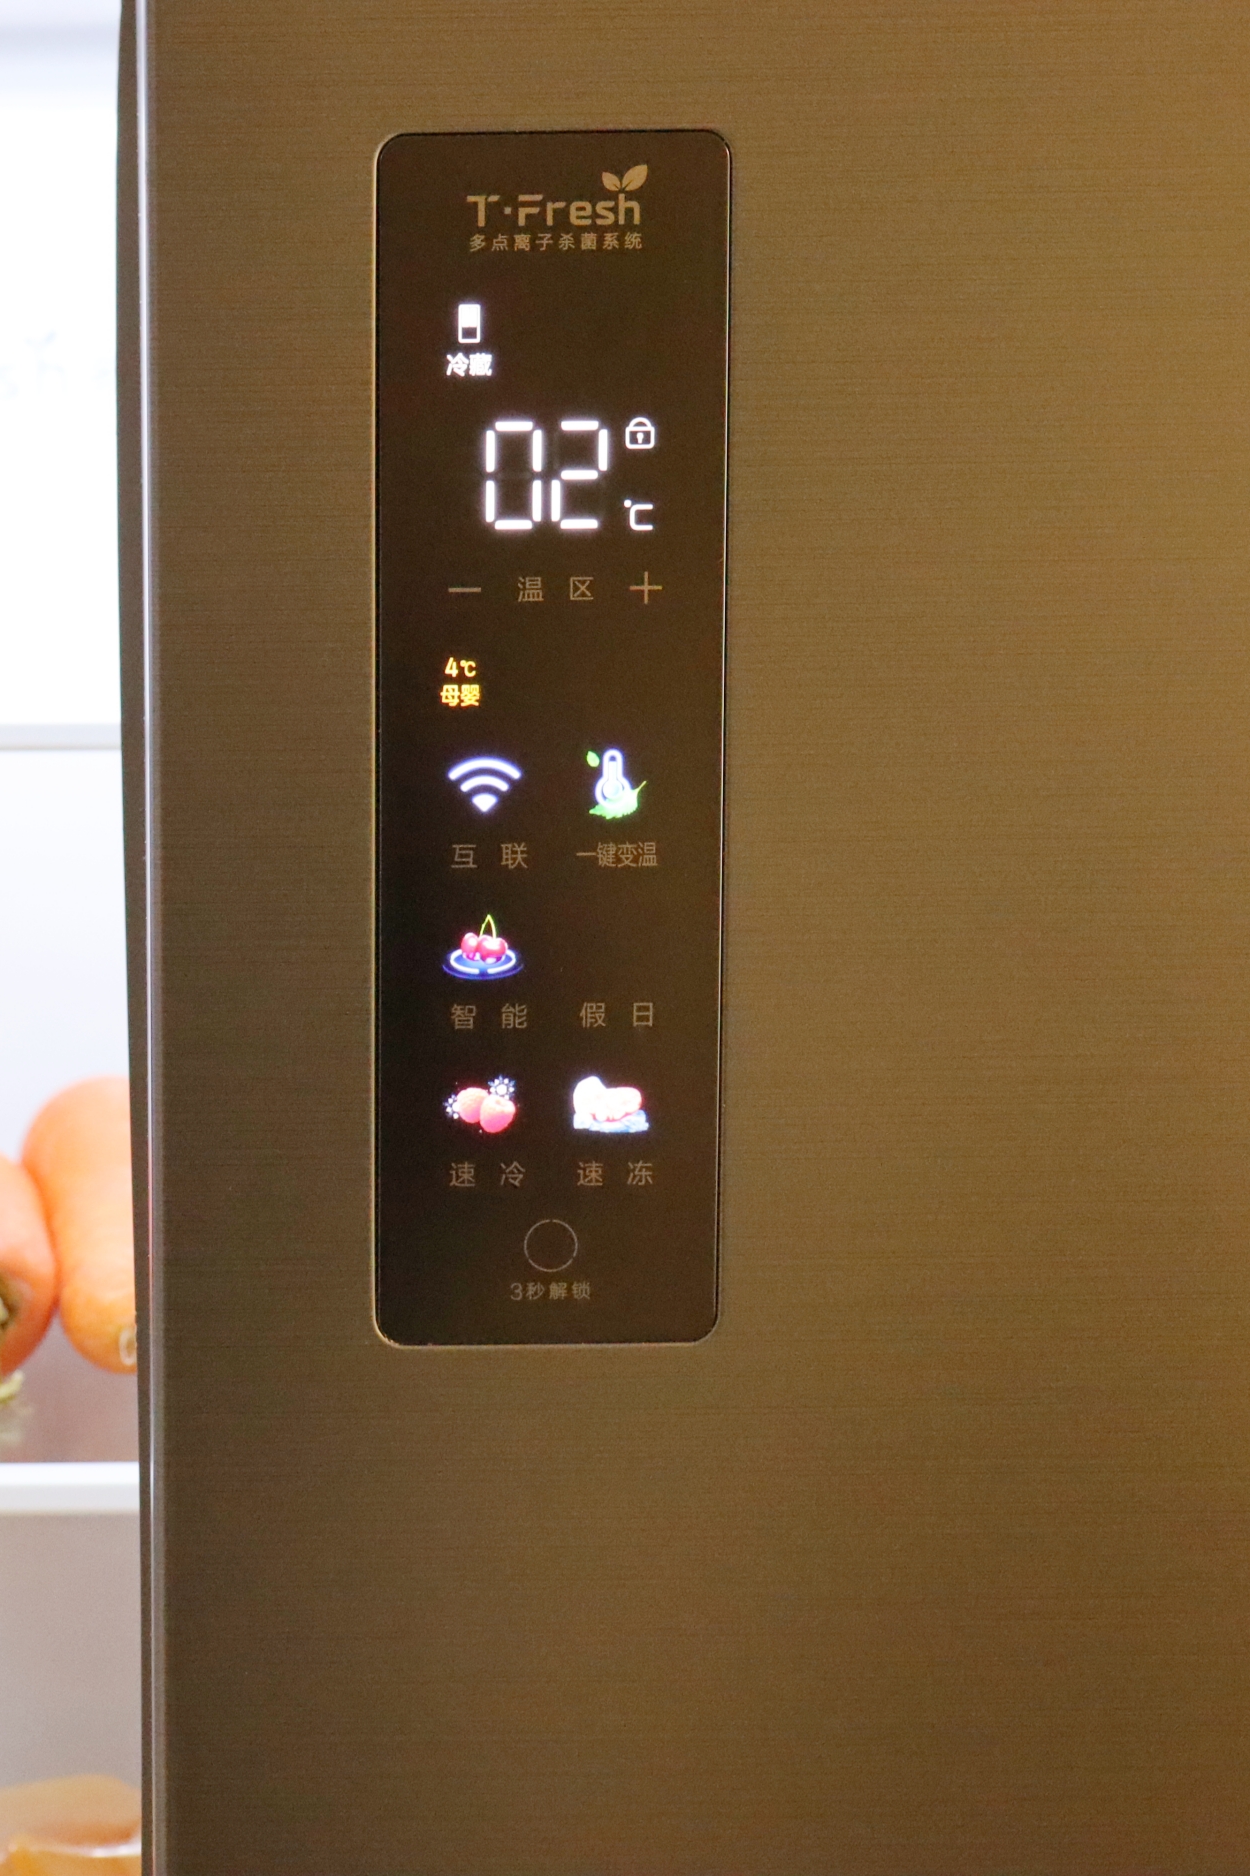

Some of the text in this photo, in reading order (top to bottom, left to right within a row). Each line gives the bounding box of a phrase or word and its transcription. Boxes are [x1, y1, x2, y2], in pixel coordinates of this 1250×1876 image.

[469, 232, 643, 252] 多点离子杀菌系统
[446, 352, 493, 377] 冷藏
[485, 420, 608, 530] 02
[517, 576, 595, 602] 温区
[440, 684, 480, 707] 母婴
[451, 843, 528, 869] 互联
[576, 842, 658, 868] 一键变温
[451, 1004, 527, 1029] 智能
[580, 1002, 654, 1028] 假日
[449, 1161, 526, 1187] 速冷
[577, 1161, 653, 1186] 速冻
[510, 1282, 591, 1301] 3秒解锁
